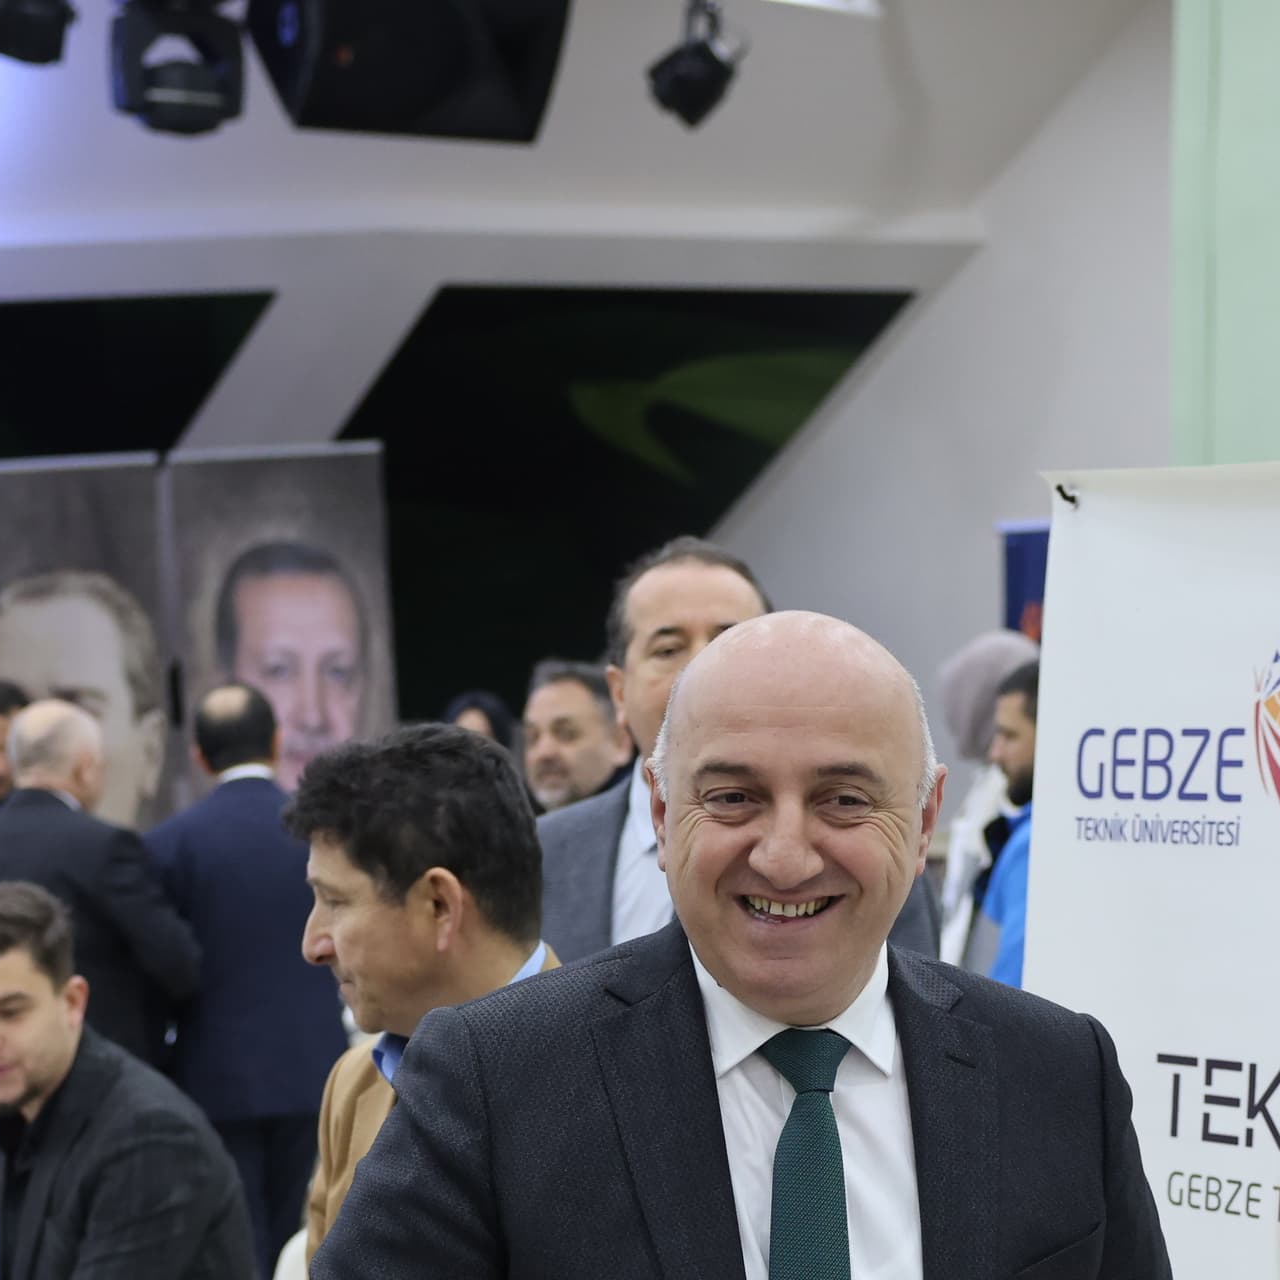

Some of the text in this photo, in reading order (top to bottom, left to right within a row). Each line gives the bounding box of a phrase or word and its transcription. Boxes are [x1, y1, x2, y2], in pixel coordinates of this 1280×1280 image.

[1076, 727, 1246, 803] GEBZE
[1074, 811, 1241, 847] TEKNİK ÜNİVERSİTESİ
[1167, 1170, 1263, 1219] GEBZE
